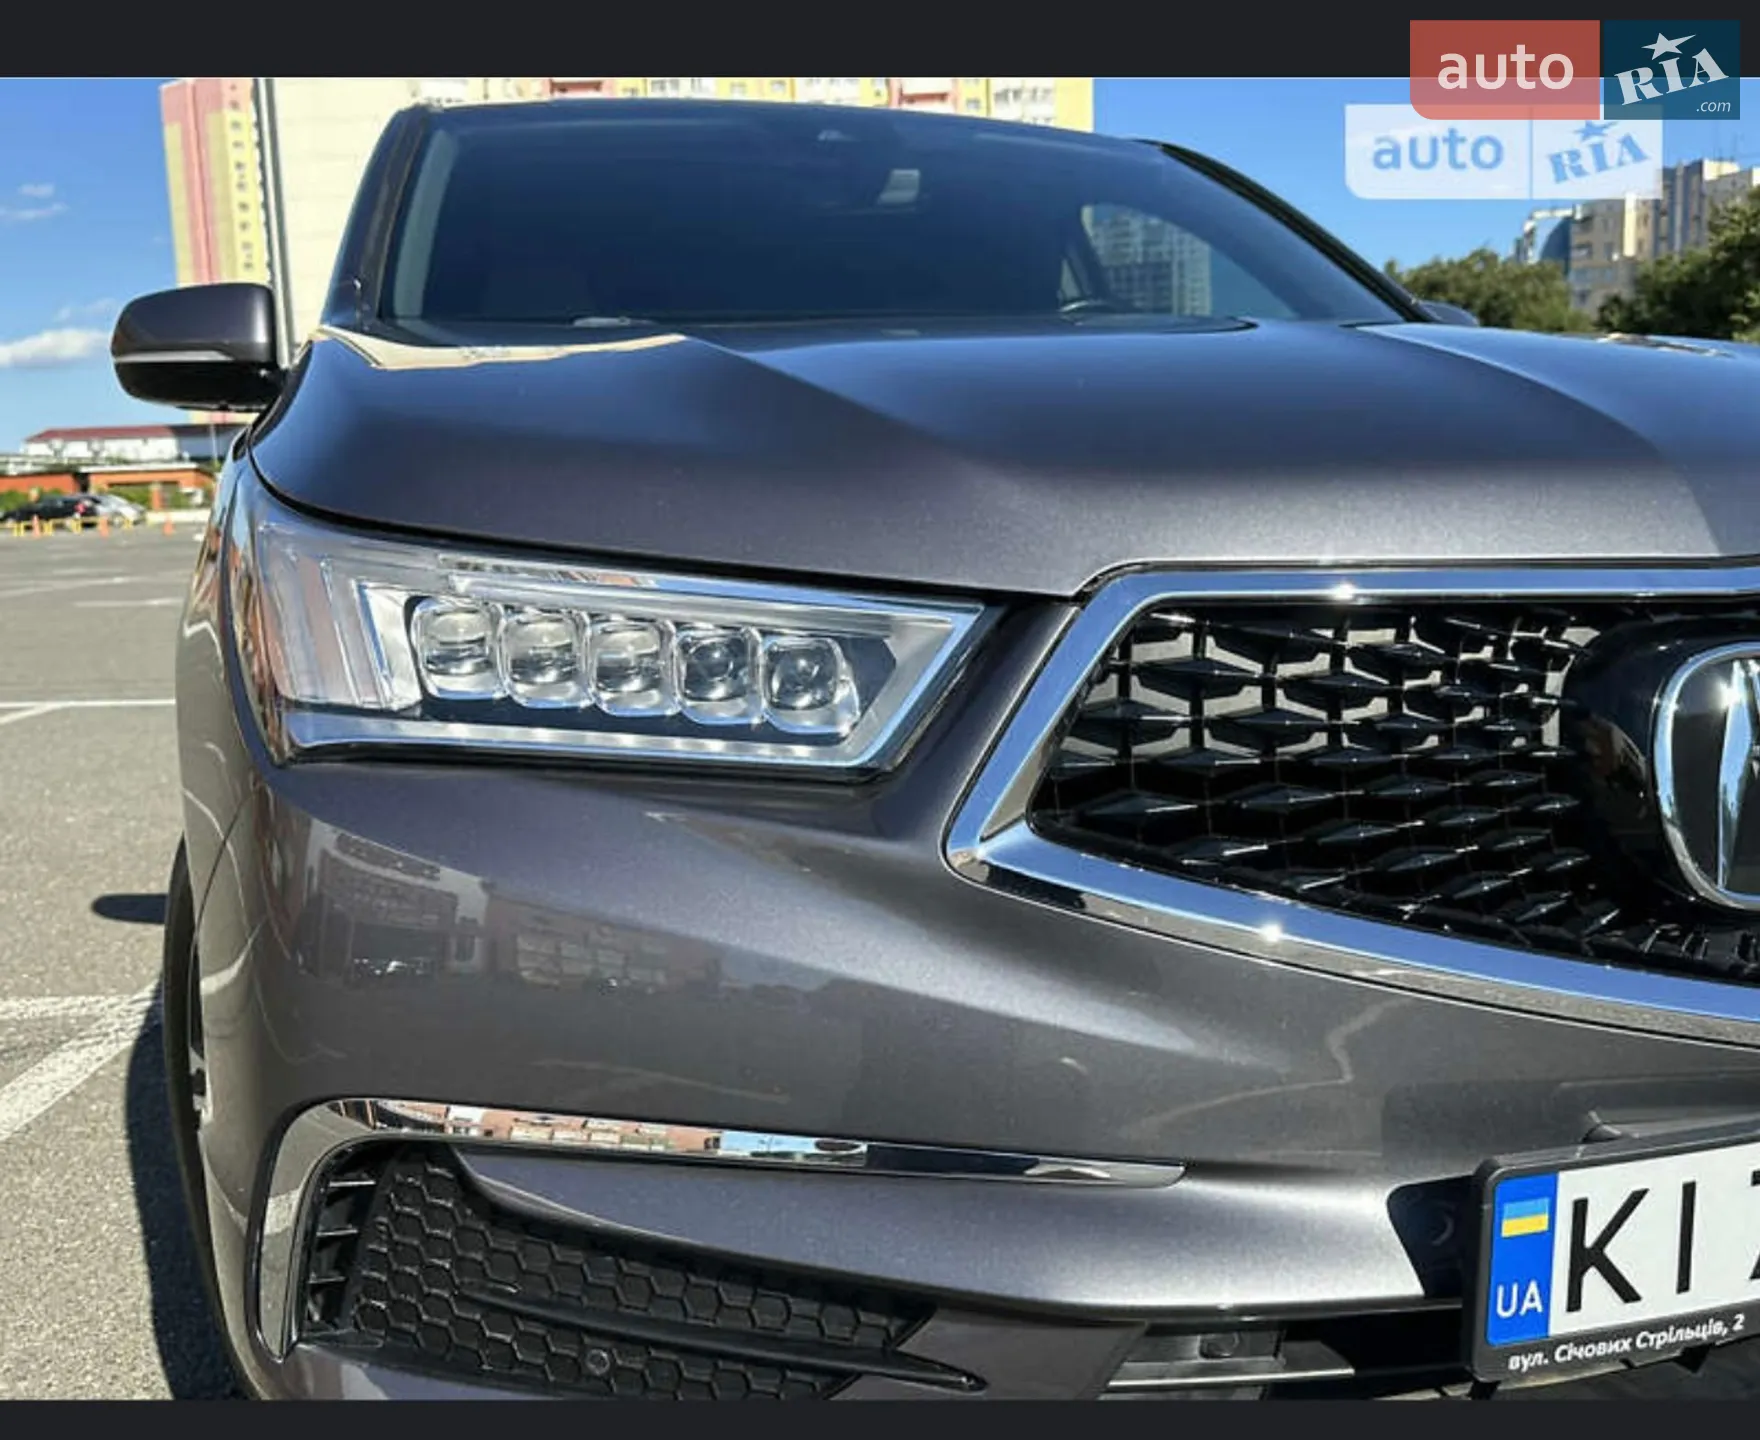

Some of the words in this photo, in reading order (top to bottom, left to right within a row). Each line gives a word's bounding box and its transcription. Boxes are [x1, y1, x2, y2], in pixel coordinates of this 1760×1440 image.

[1496, 1280, 1544, 1318] UA
[1508, 1353, 1548, 1372] вул.
[1554, 1336, 1632, 1363] Січових
[1635, 1317, 1728, 1349] Стрільців,
[1733, 1313, 1745, 1331] 2
